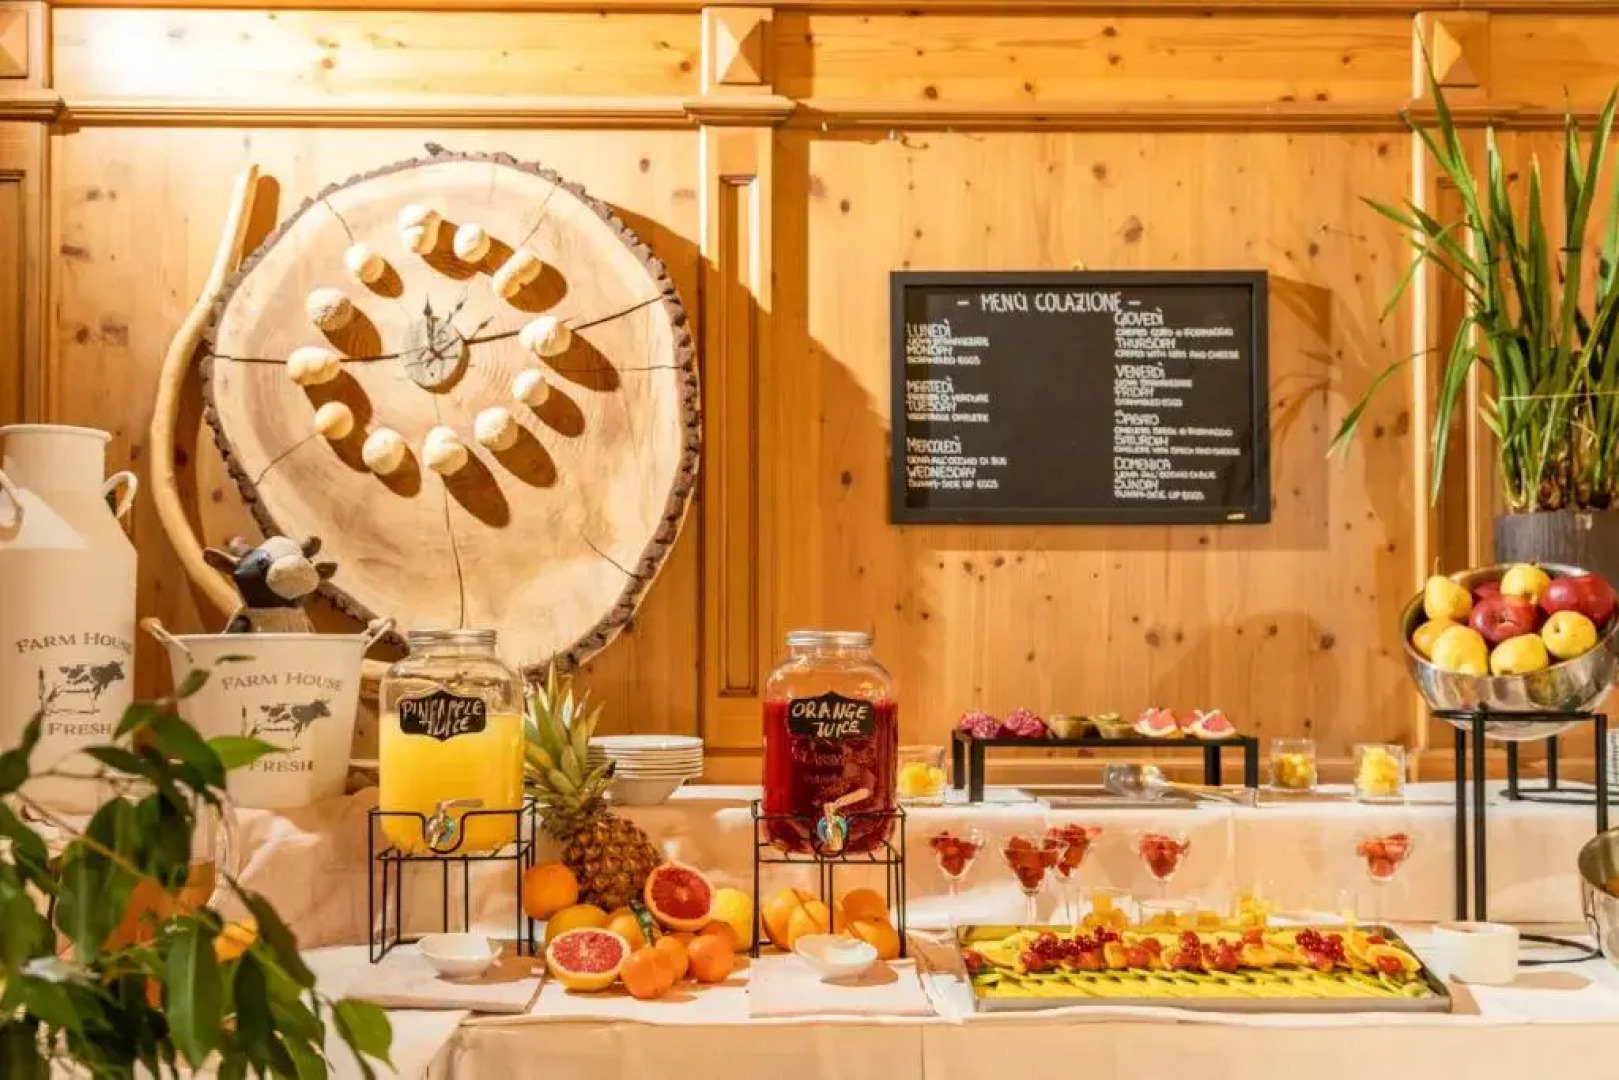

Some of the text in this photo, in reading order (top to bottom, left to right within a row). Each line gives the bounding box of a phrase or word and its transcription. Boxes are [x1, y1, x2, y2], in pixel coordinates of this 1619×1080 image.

[1035, 291, 1122, 313] COLAZIONE
[1114, 336, 1176, 349] THURSDAY
[907, 345, 953, 357] MONDAY
[1113, 386, 1154, 398] FRIDAY
[905, 400, 957, 412] TUESDAY
[906, 466, 976, 478] WEDNESDAY
[1113, 478, 1159, 491] SUNDAY
[16, 633, 76, 654] FARM
[221, 671, 343, 691] FARM HOUSE
[791, 702, 869, 721] ORANGE
[48, 722, 112, 736] FRESH
[812, 719, 860, 738] JUICE
